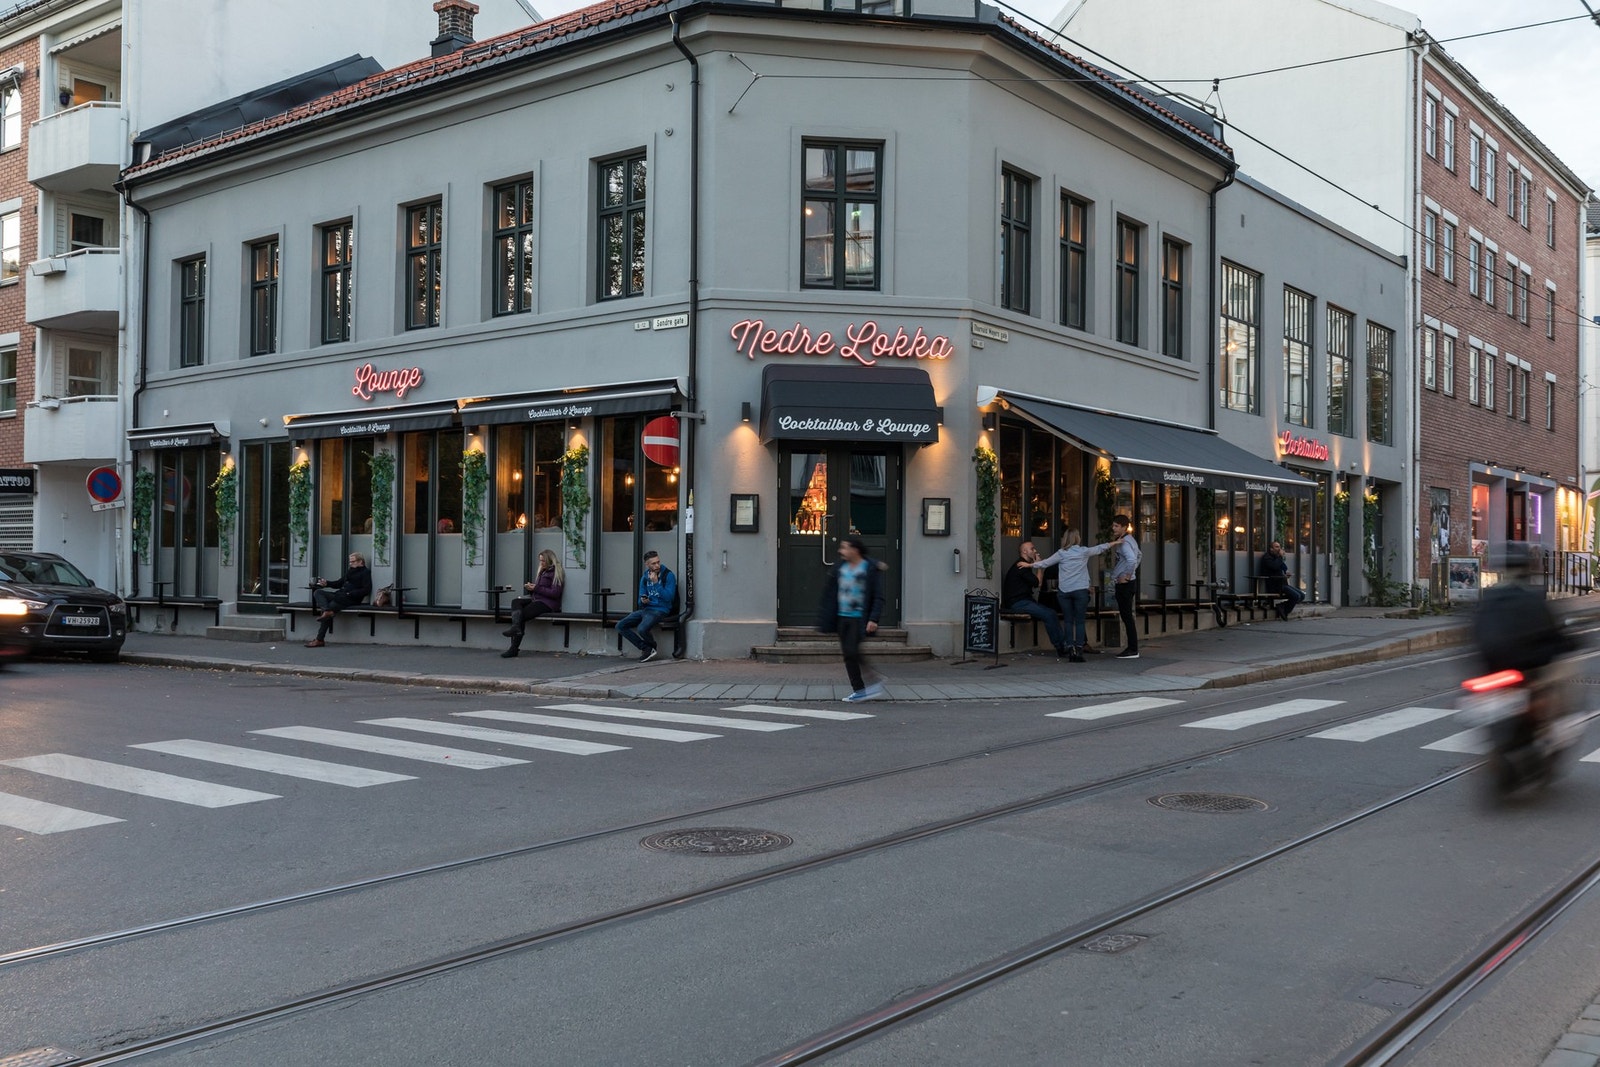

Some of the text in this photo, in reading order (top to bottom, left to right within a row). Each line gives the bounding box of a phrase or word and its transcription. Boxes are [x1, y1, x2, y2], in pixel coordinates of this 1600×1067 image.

[730, 318, 836, 361] Nedre
[352, 362, 422, 401] Lounge
[528, 408, 562, 419] Cocktailbar
[568, 404, 592, 417] Lounge
[340, 425, 366, 435] Cocktailbar
[372, 422, 391, 433] Lounge
[778, 415, 931, 438] Cocktailbar & Lounge
[1278, 430, 1329, 461] Cocktailbar
[1190, 473, 1205, 485] Lounge
